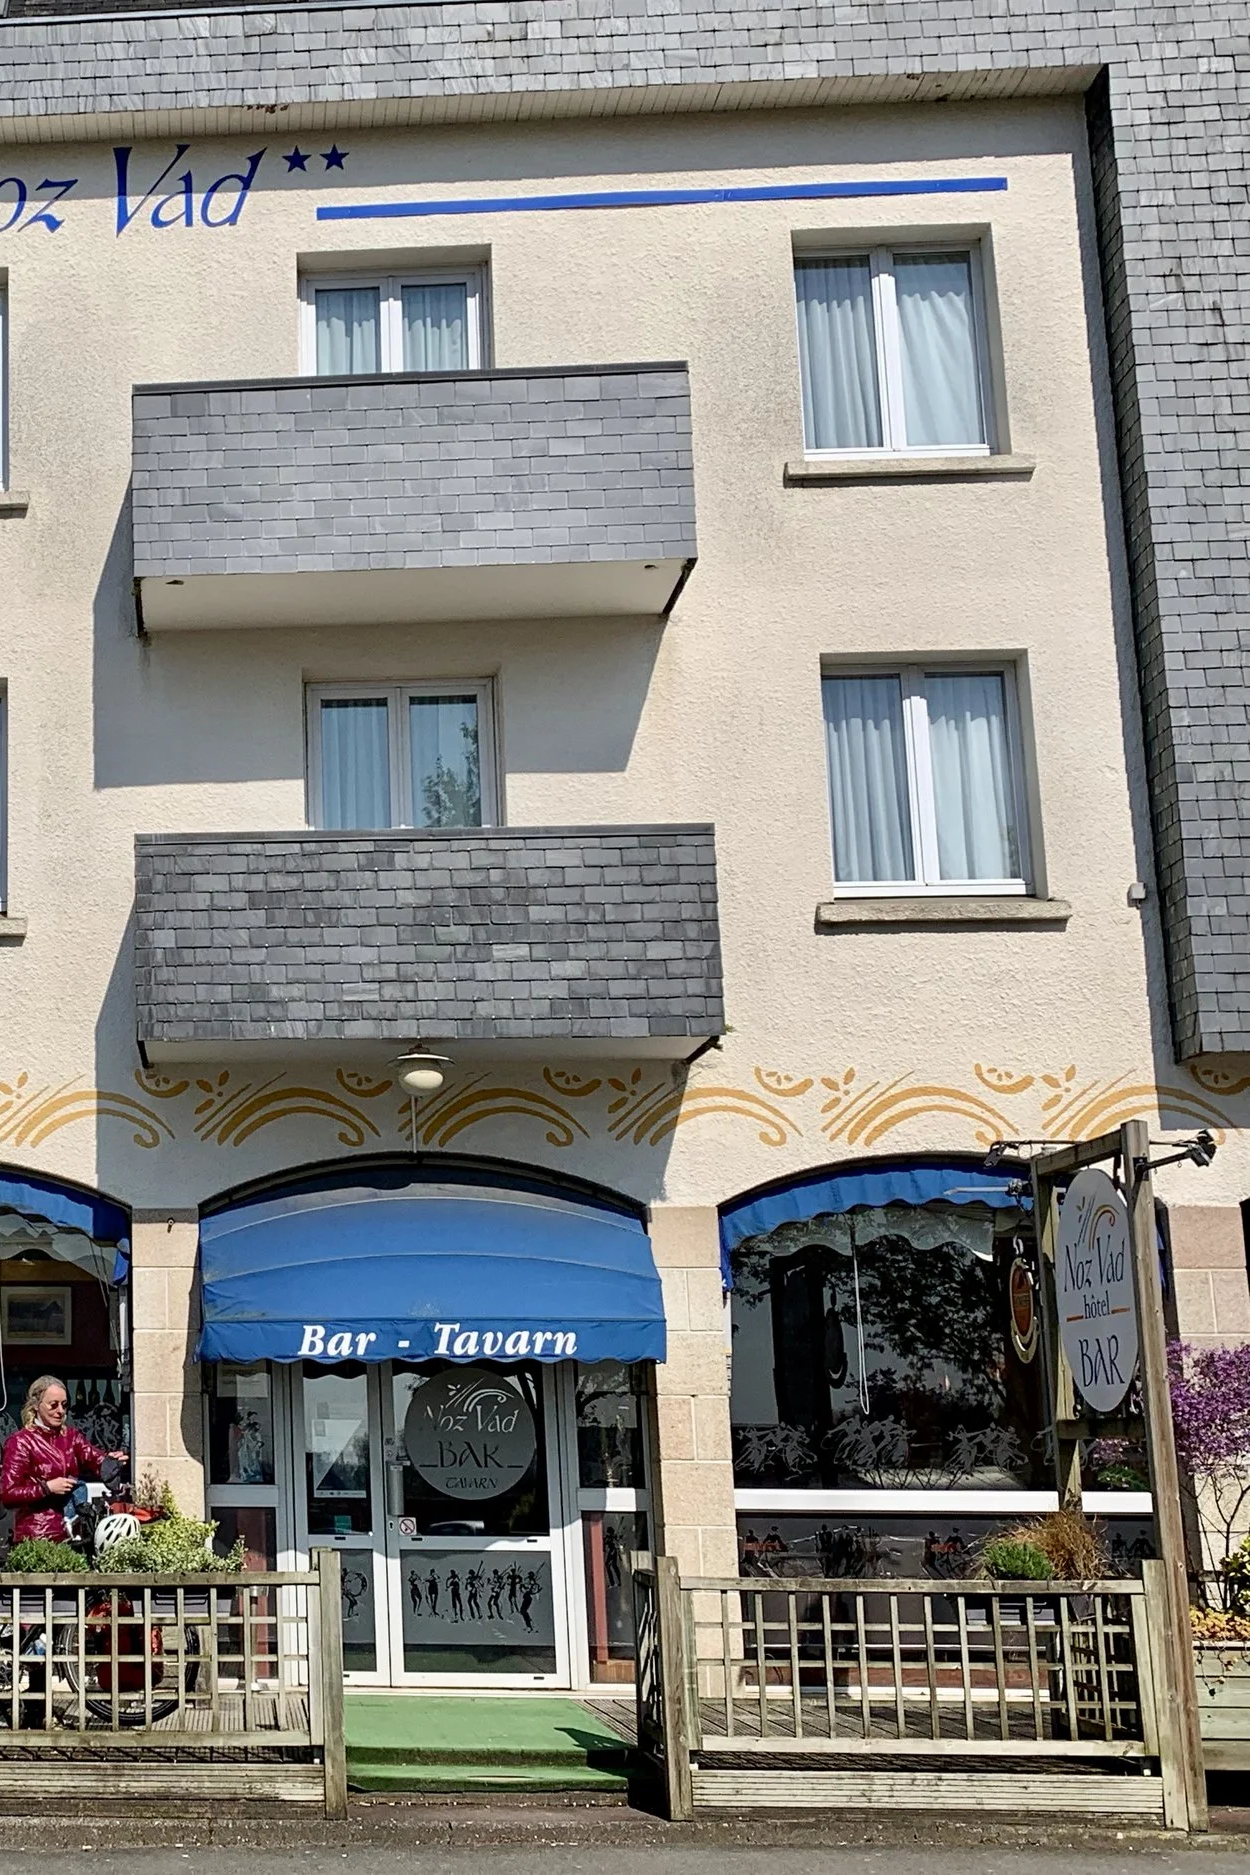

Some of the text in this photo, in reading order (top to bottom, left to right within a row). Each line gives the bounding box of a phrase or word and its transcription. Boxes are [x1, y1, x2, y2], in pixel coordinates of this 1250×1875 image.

[112, 144, 268, 238] Vad
[1064, 1234, 1125, 1293] Noz Vad
[1083, 1290, 1111, 1320] hôtel
[297, 1324, 377, 1356] Bar
[433, 1322, 578, 1356] Tavarn
[1078, 1334, 1125, 1388] BAR
[476, 1405, 519, 1433] Vad
